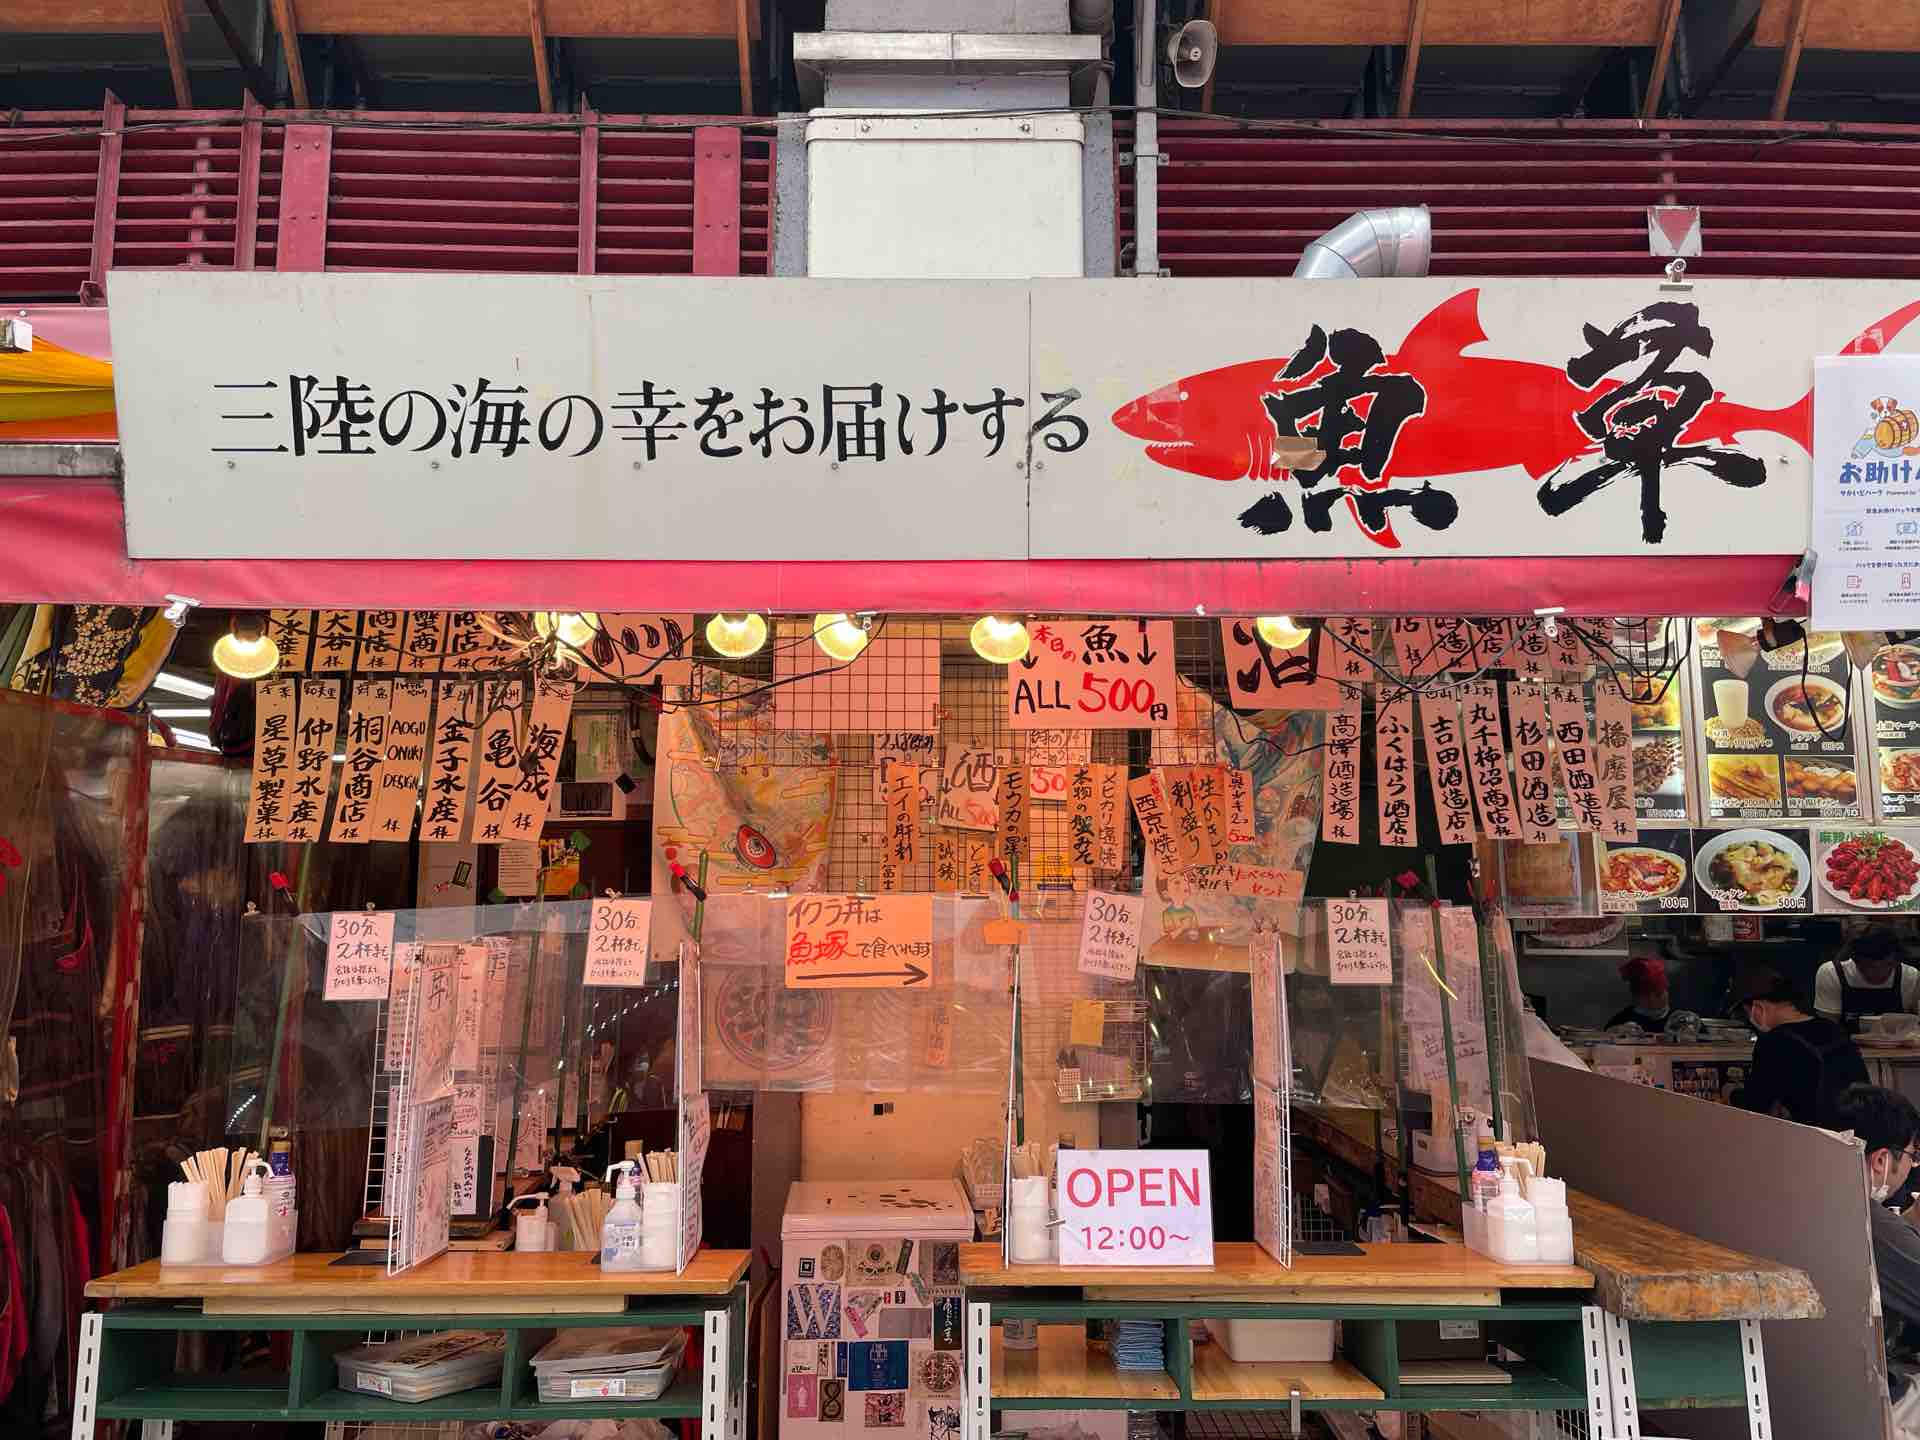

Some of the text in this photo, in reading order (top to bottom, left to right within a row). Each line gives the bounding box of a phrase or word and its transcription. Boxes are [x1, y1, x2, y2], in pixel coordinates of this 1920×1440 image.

[210, 373, 1091, 462] 三陸の海の幸をお届けする
[1237, 302, 1768, 544] 魚草
[1840, 459, 1920, 484] お助け
[1014, 671, 1169, 721] ALL 500円
[1512, 685, 1541, 697] 小山
[950, 750, 997, 793] 酒
[1556, 720, 1604, 832] 西田酒造店
[788, 898, 884, 929] イクラ丼は
[1660, 897, 1689, 910] 700円
[1777, 897, 1806, 909] 500円
[1066, 1167, 1201, 1208] OPEN
